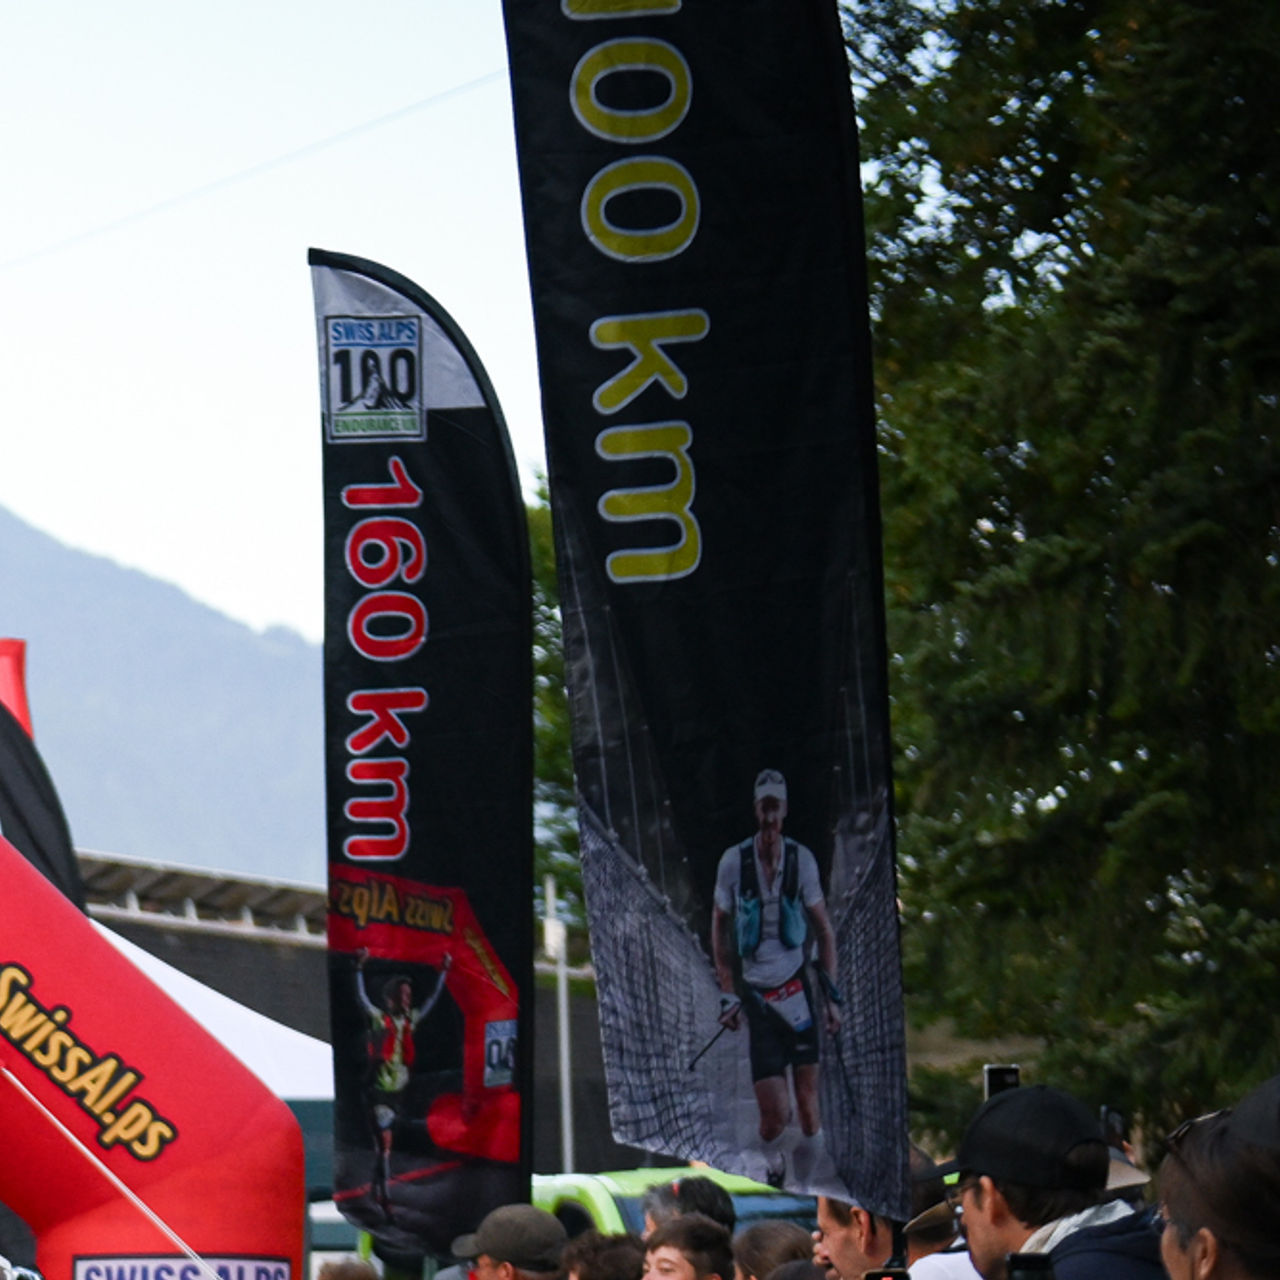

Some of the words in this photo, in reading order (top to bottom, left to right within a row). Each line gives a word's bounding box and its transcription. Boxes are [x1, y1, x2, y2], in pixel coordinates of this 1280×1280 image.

[332, 348, 418, 406] 100
[377, 320, 418, 341] ALPS
[589, 307, 711, 584] km
[341, 455, 429, 662] 160
[342, 686, 430, 860] km
